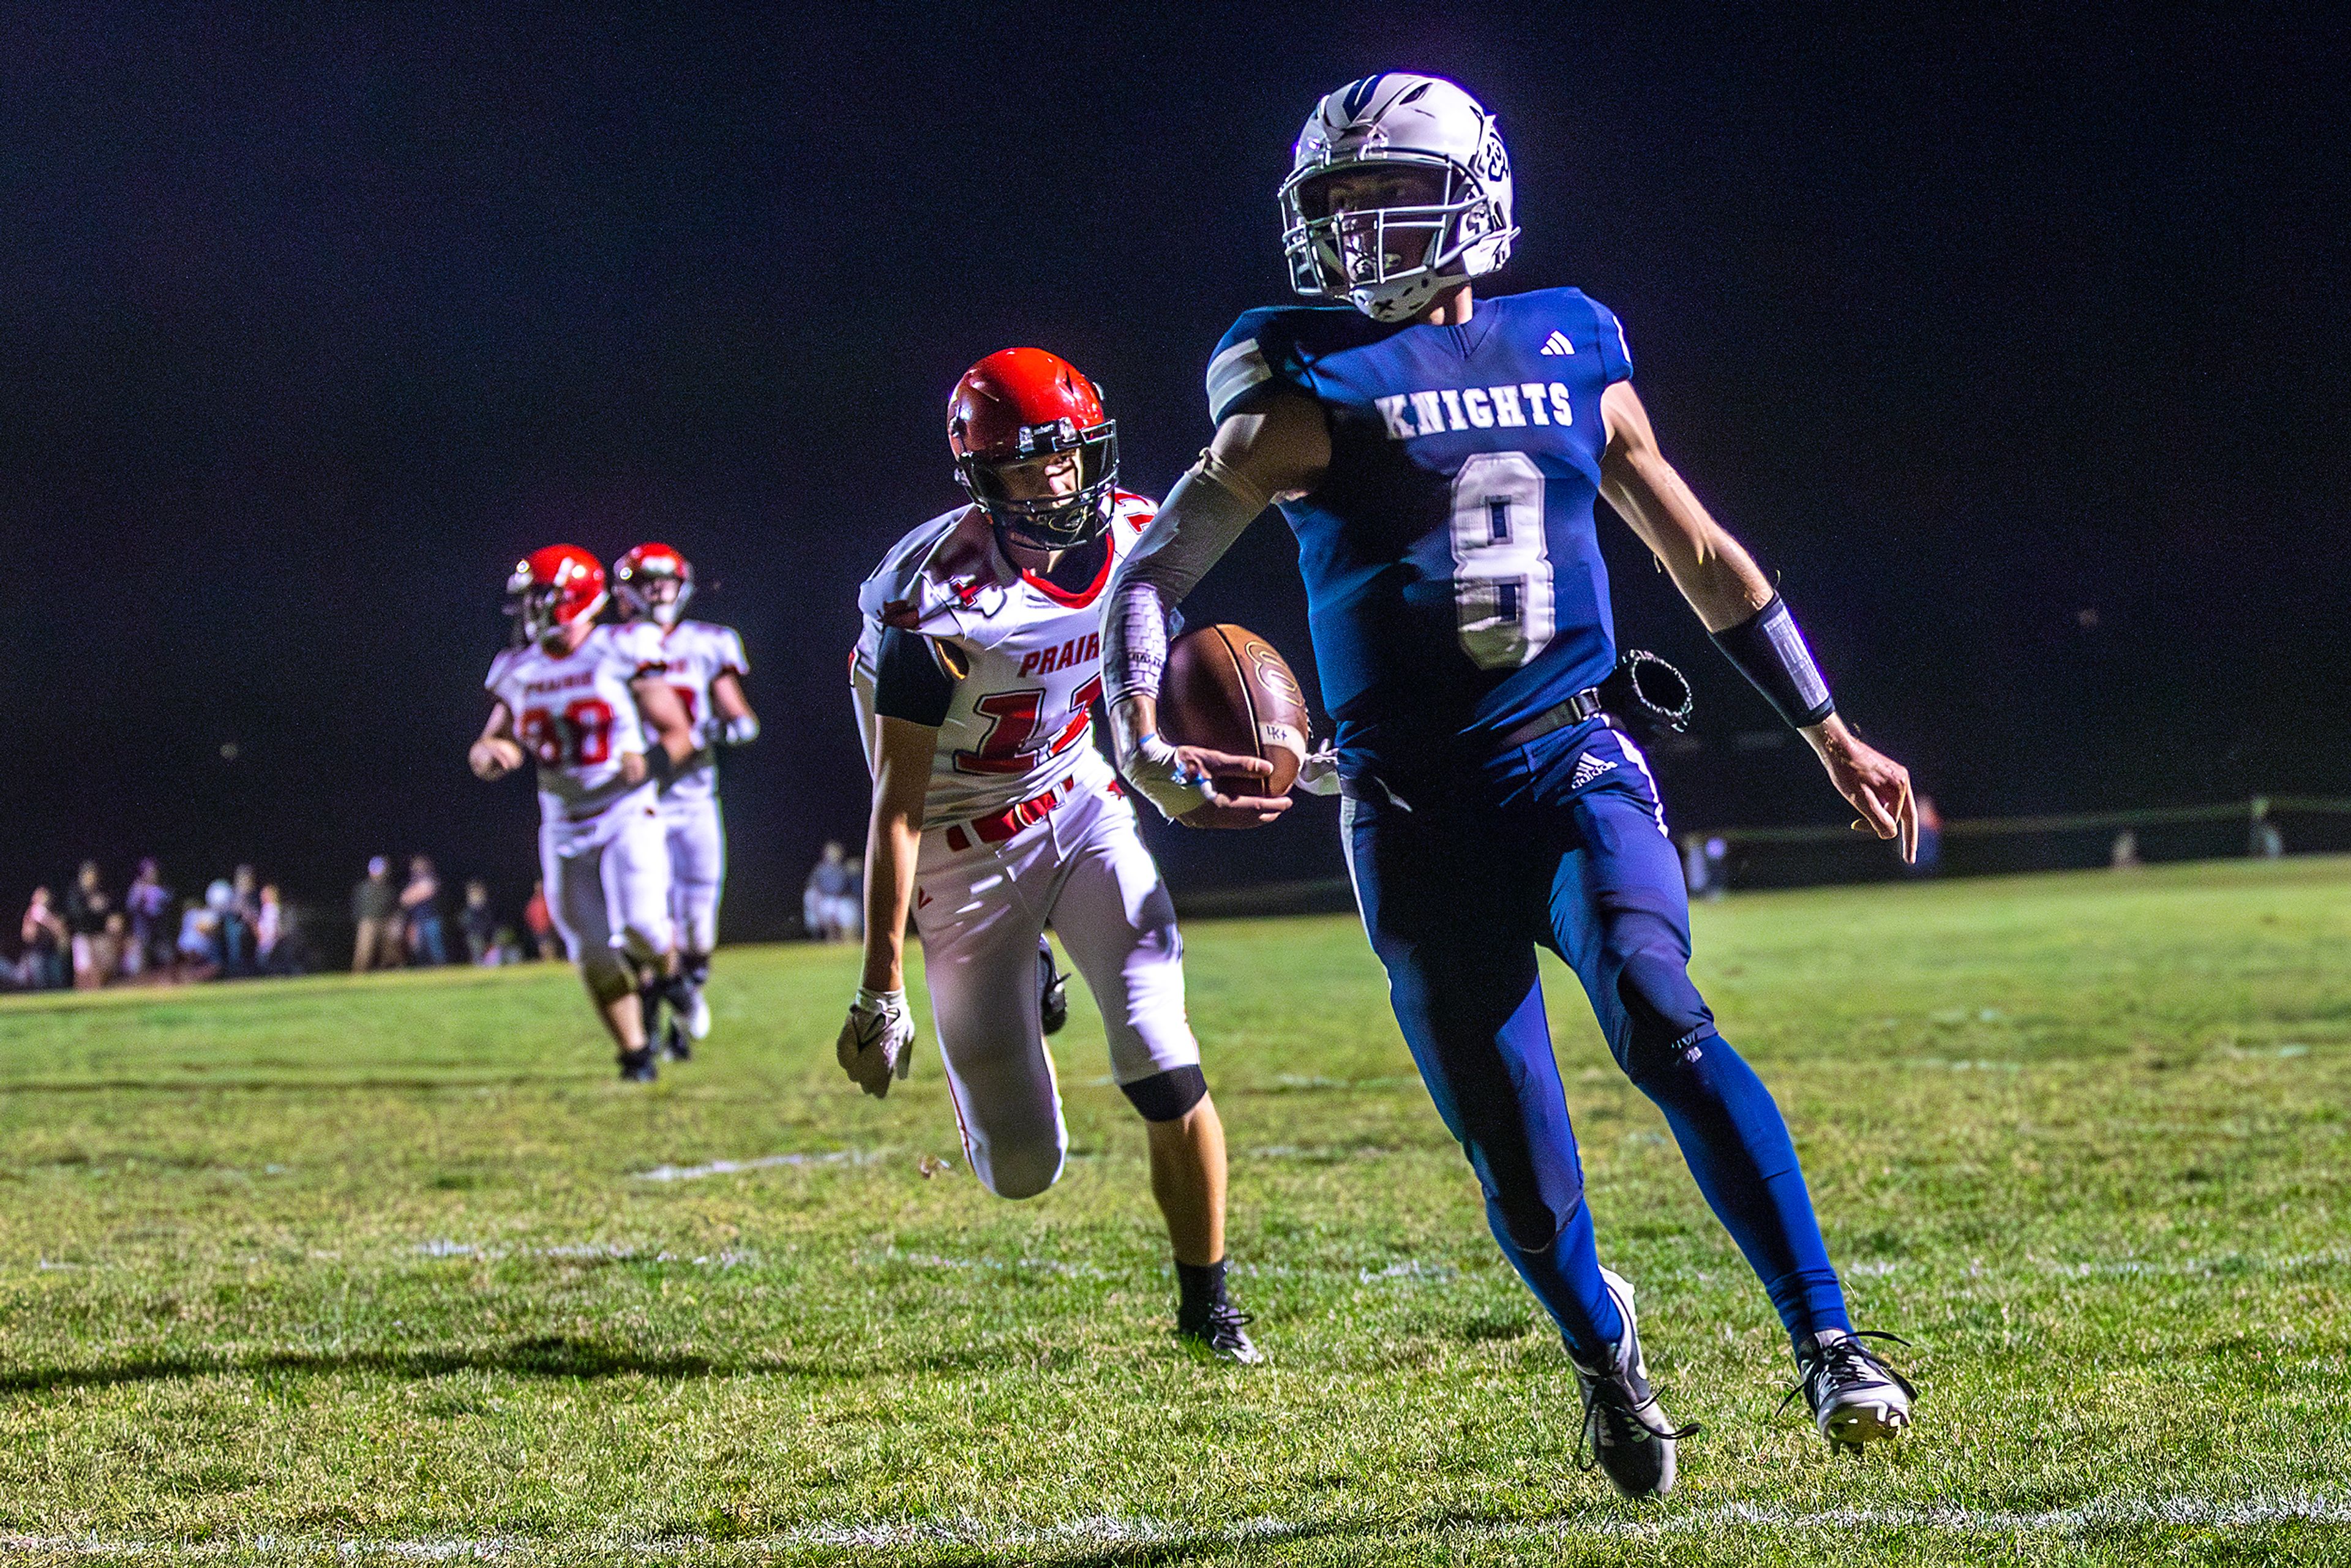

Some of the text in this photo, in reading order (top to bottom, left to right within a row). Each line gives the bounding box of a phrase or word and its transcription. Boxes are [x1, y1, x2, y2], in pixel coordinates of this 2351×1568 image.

[1374, 382, 1573, 440] KNIGHTS
[1450, 451, 1556, 671] 8
[1571, 760, 1619, 789] adidas
